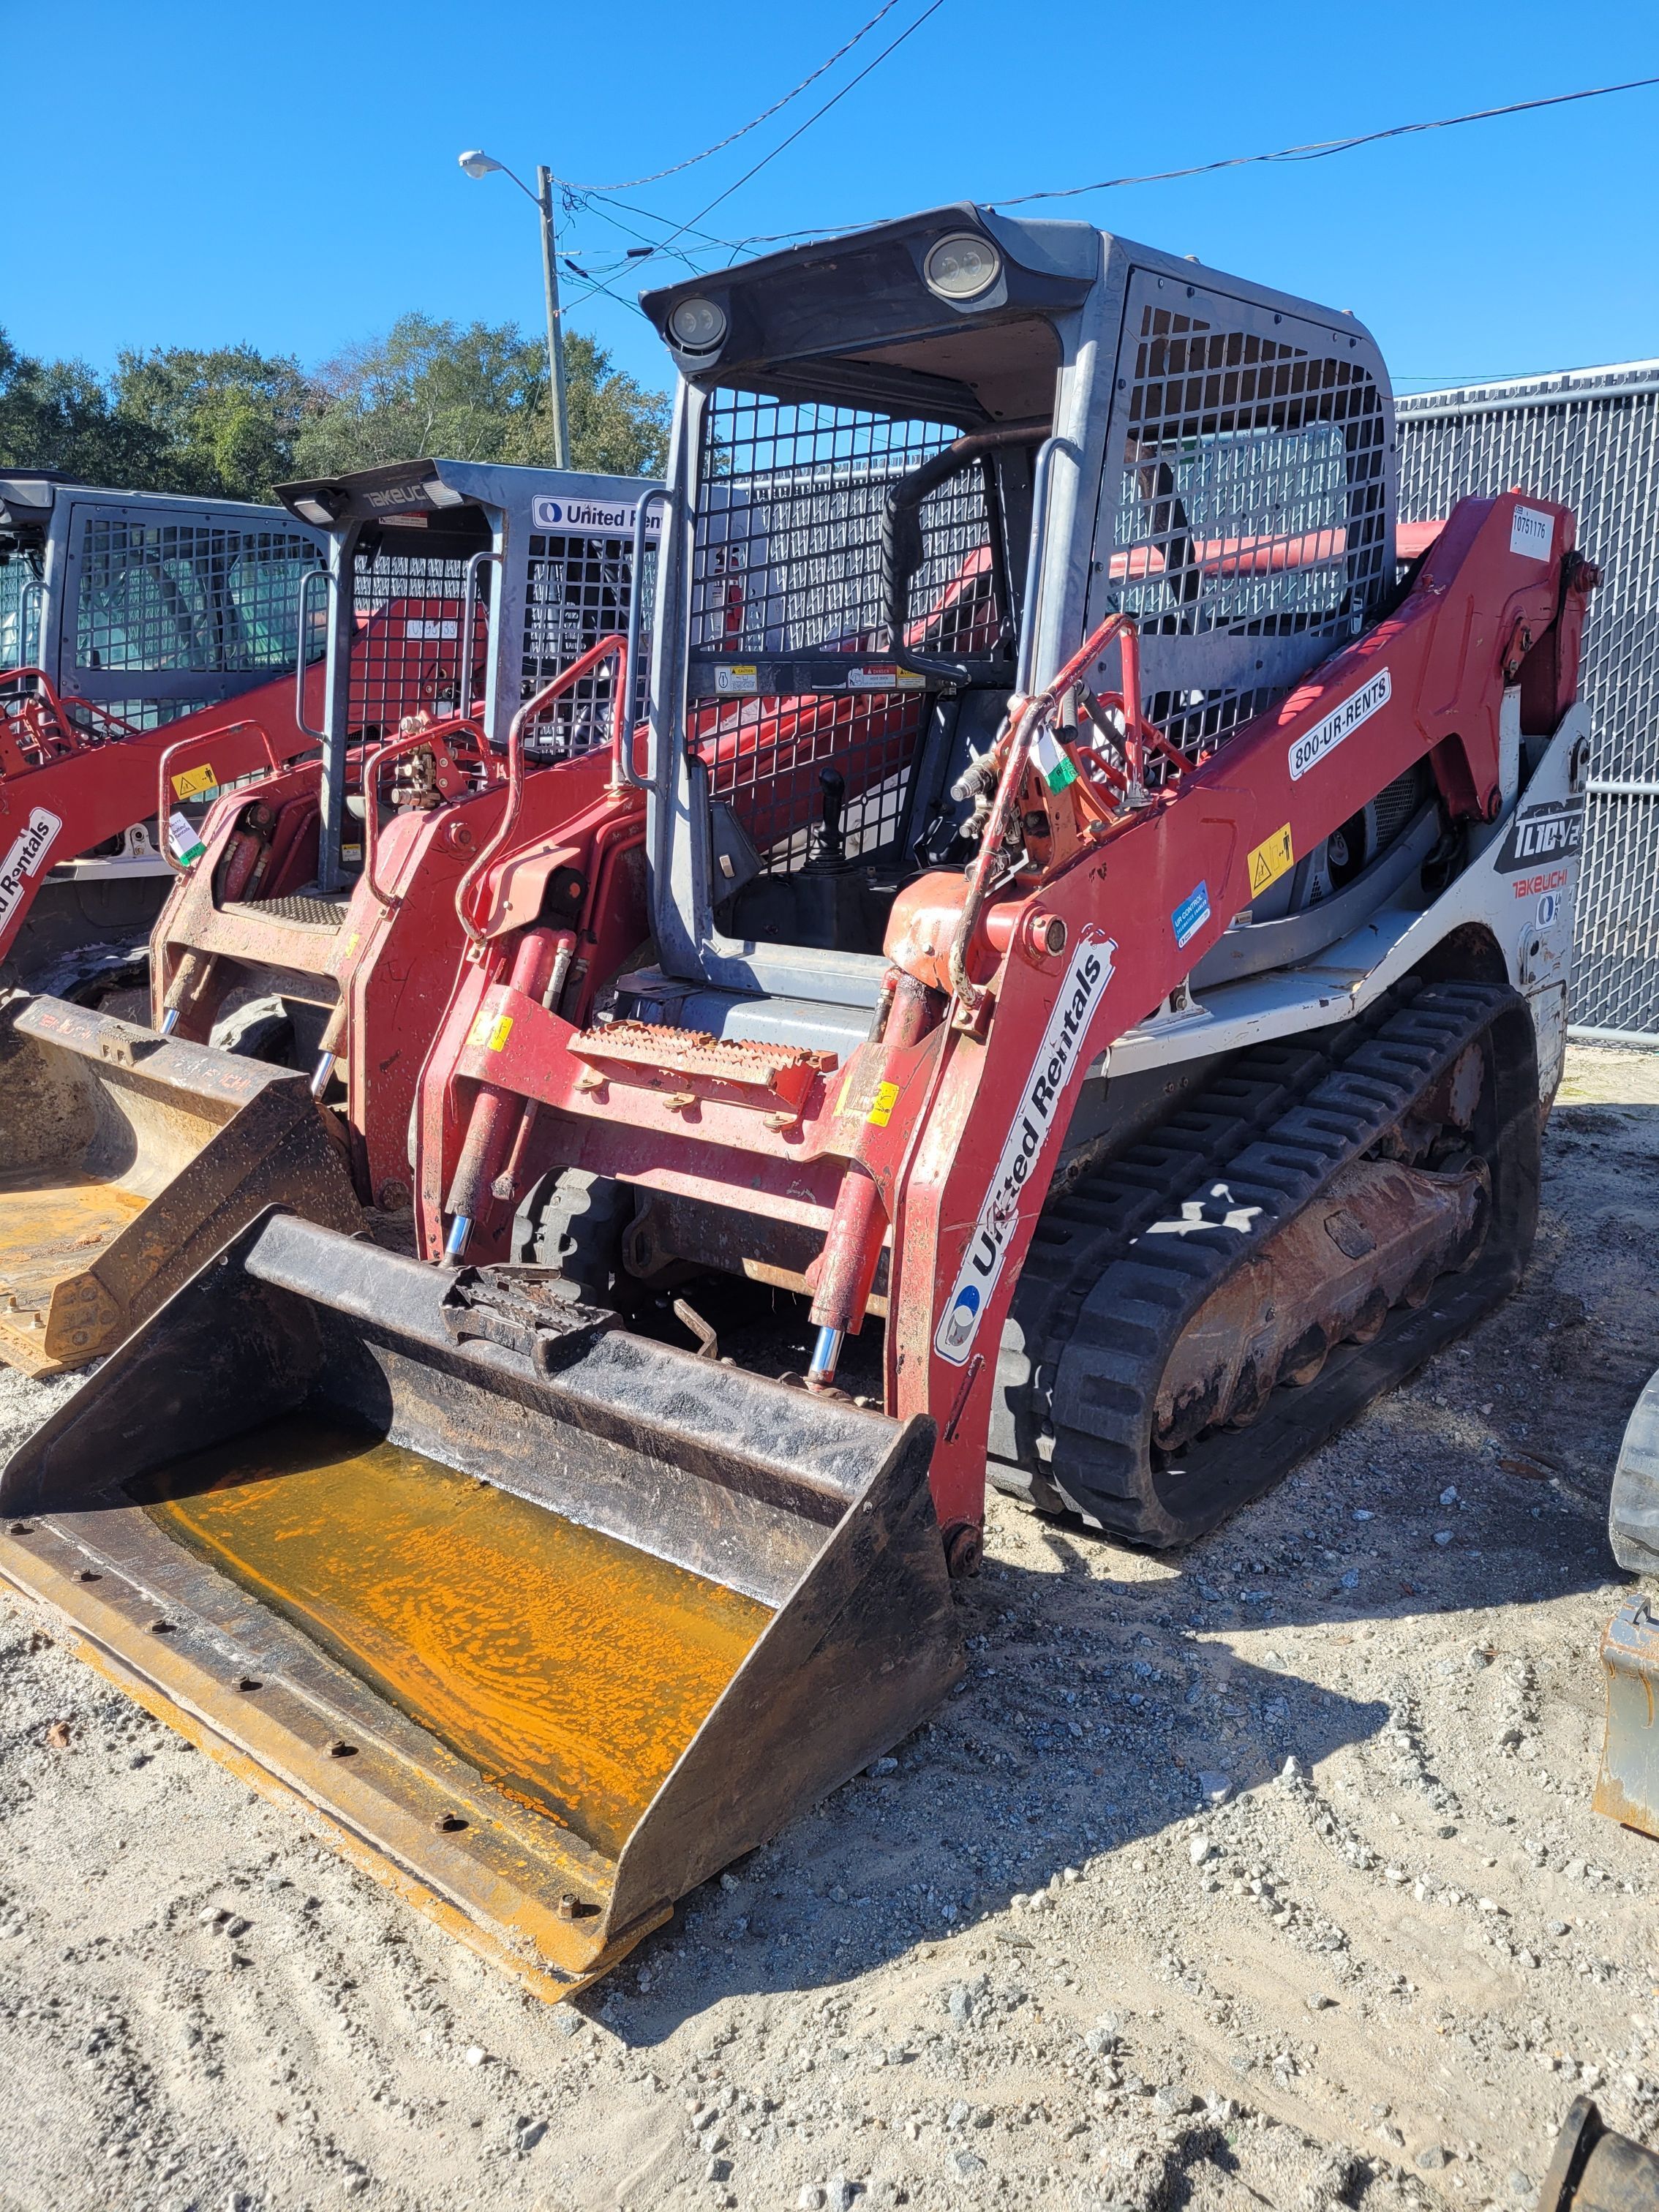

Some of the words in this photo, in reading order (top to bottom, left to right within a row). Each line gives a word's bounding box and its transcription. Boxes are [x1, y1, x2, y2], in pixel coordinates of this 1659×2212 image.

[363, 485, 428, 508] TAKEUC
[567, 505, 625, 527] United
[1514, 515, 1545, 539] 10751176
[1295, 677, 1386, 770] 800-UR-RENTS
[1512, 868, 1568, 899] TAKEUCHI
[1175, 917, 1183, 928] UR
[1182, 895, 1203, 919] CONTROL
[972, 1117, 1039, 1276] Uited
[1031, 954, 1100, 1119] Rentals
